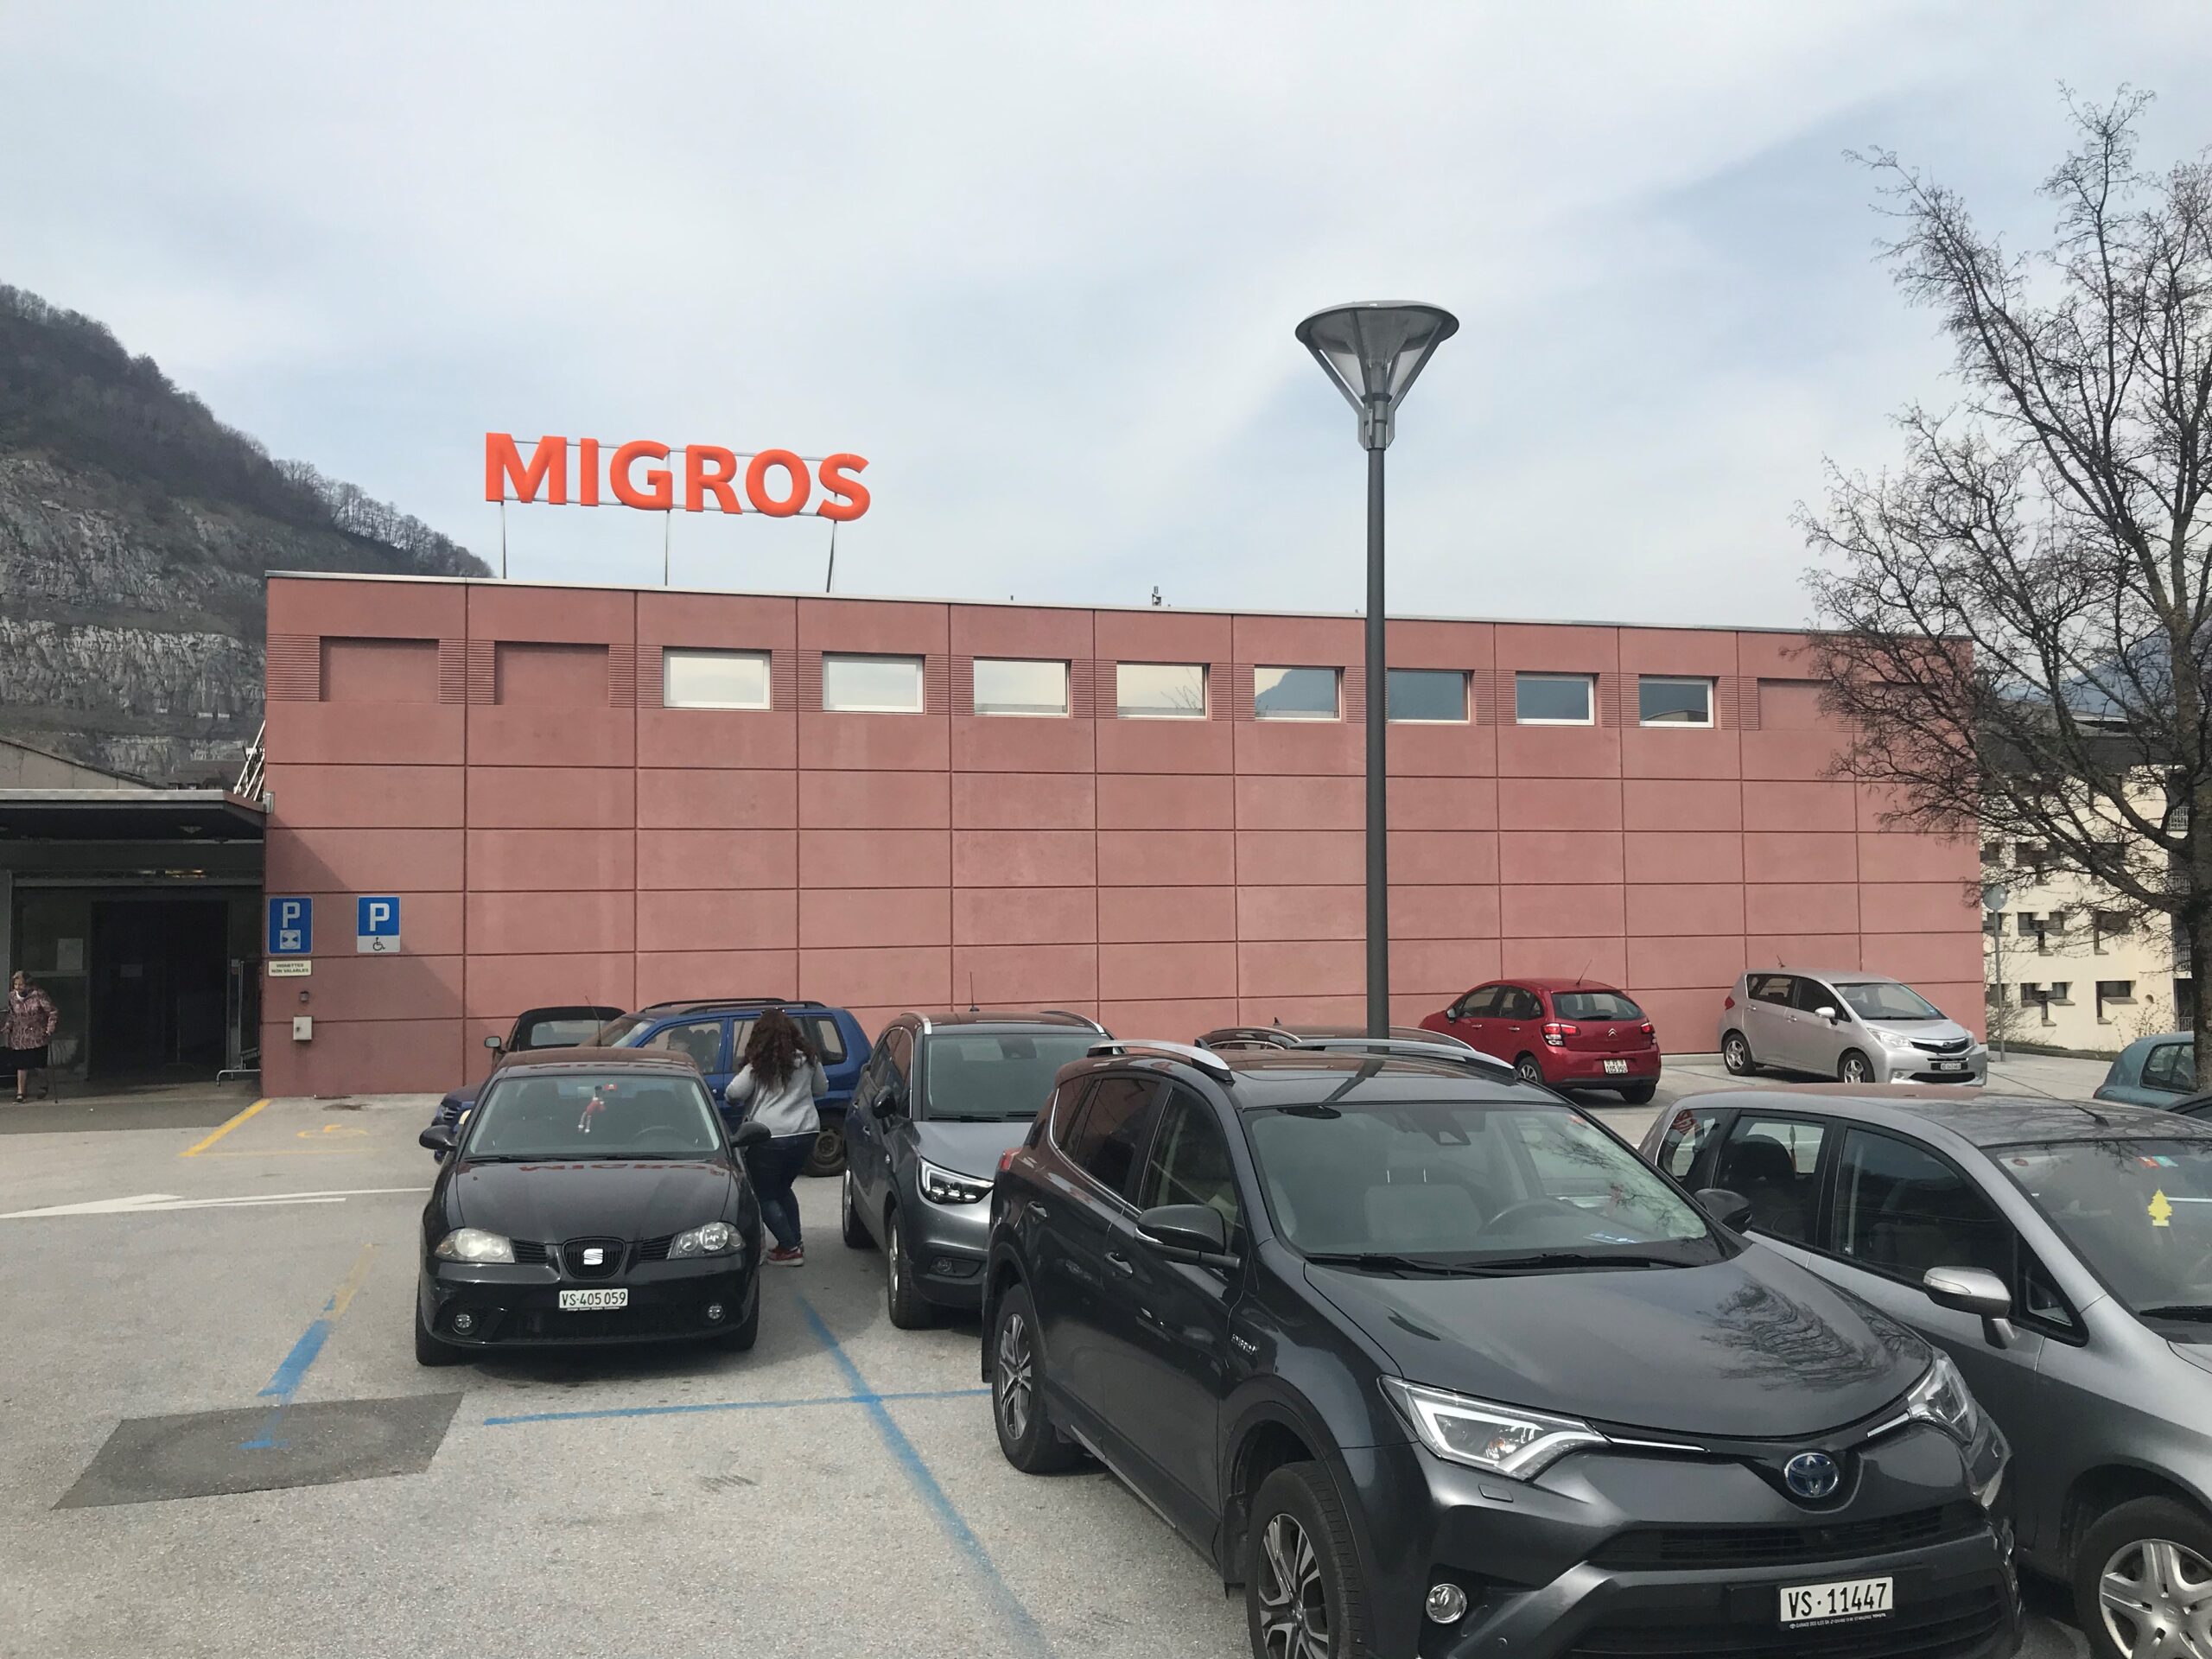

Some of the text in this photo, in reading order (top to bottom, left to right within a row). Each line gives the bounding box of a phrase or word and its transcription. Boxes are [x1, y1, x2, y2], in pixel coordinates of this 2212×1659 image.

[485, 432, 871, 522] MIGROS
[282, 901, 301, 929] P
[369, 902, 391, 932] P
